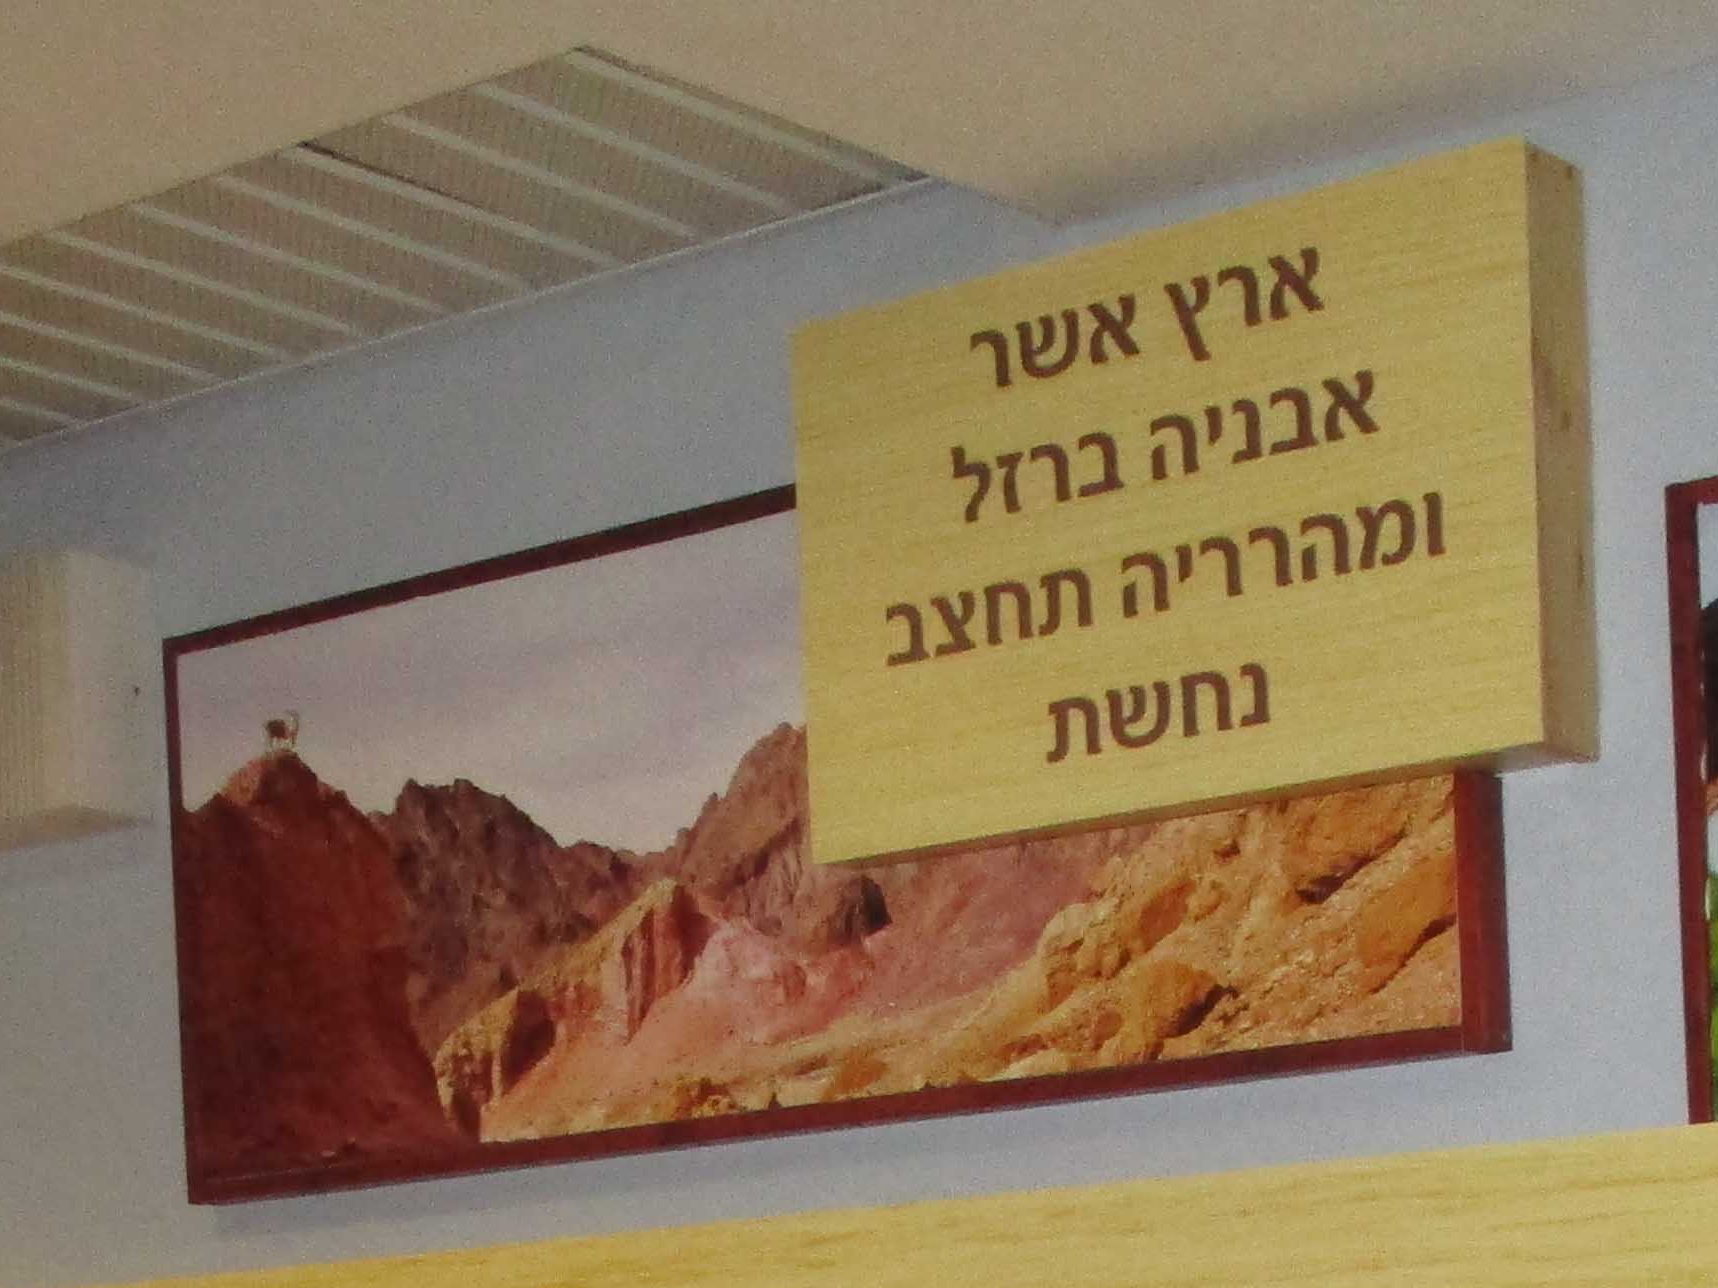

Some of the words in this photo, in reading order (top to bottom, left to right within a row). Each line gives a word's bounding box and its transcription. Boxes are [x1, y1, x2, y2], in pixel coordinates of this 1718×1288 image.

[970, 293, 1140, 388] אשר
[1164, 247, 1324, 361] ארץ
[1149, 369, 1380, 480] אבניה
[952, 430, 1124, 523] ברזל
[1122, 492, 1447, 618] ומהרריה
[885, 568, 1094, 668] תחצב
[1046, 663, 1272, 763] נחשת
